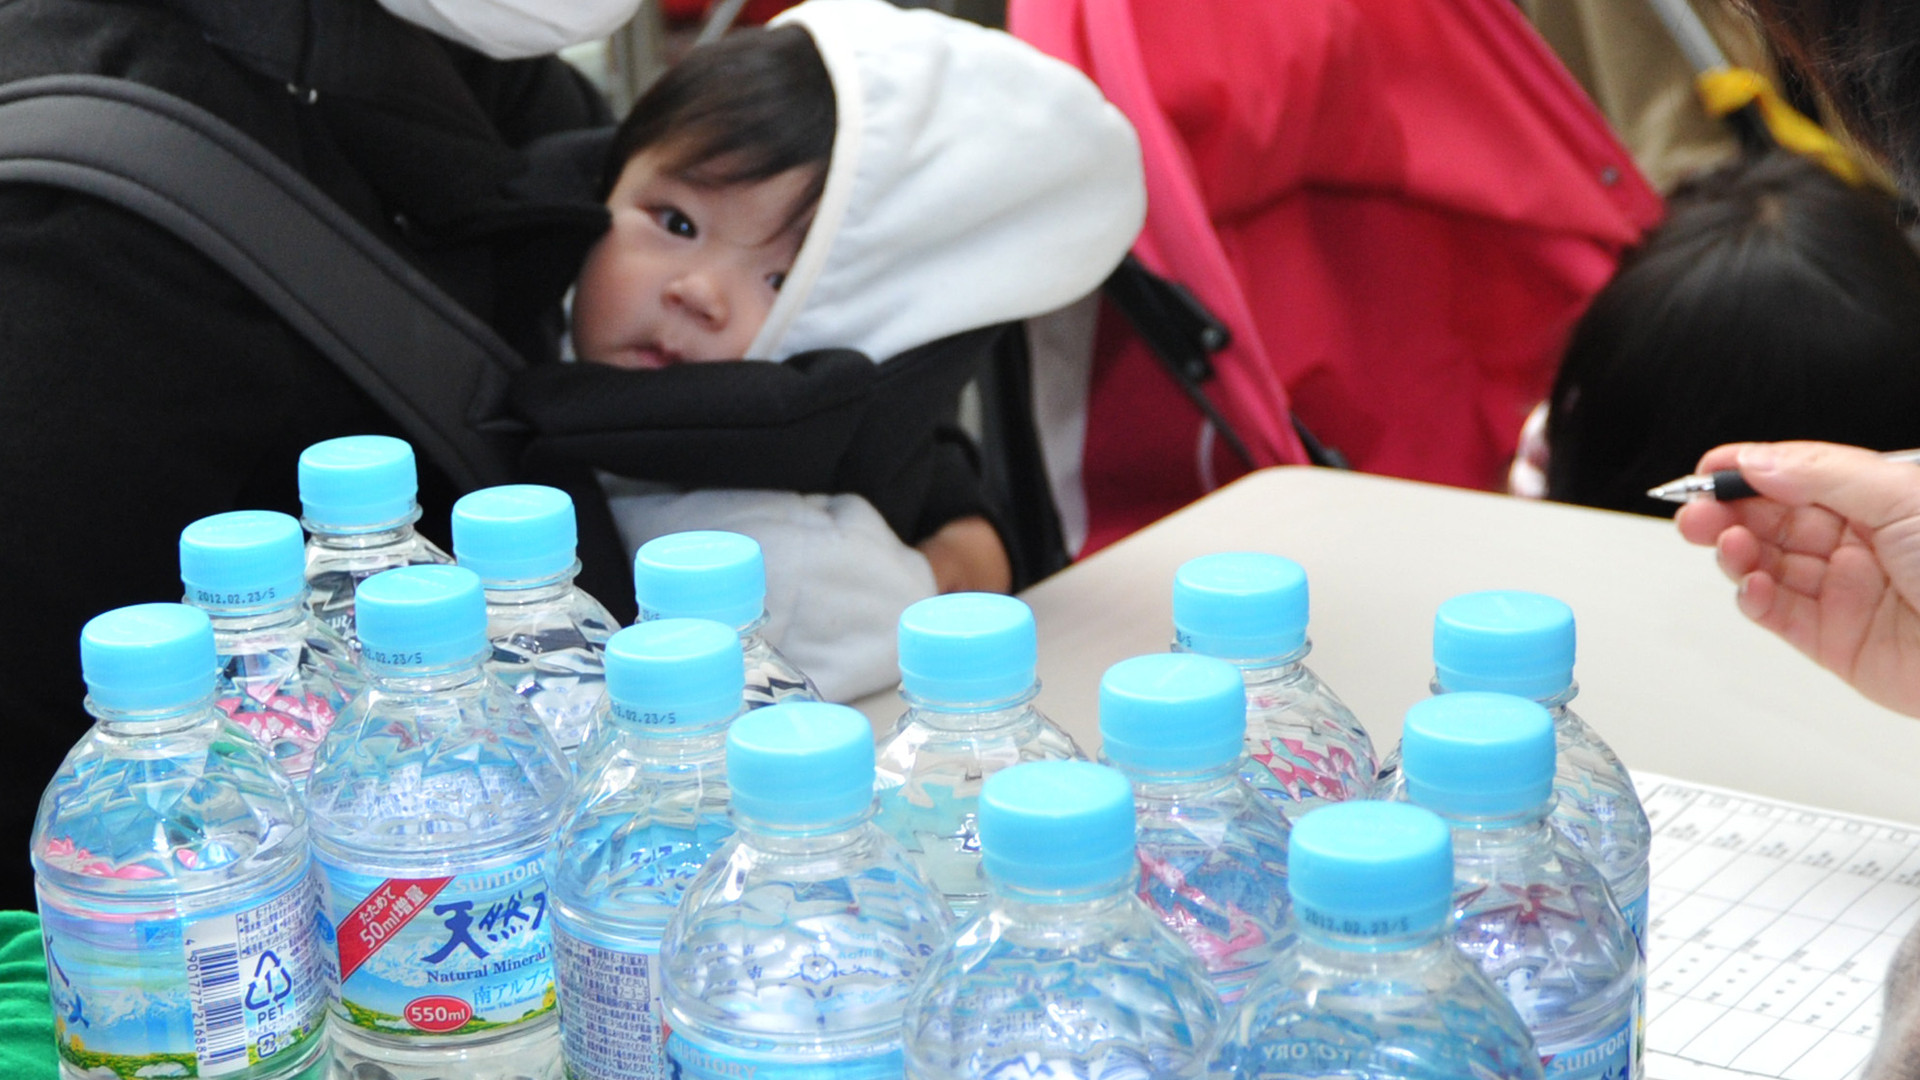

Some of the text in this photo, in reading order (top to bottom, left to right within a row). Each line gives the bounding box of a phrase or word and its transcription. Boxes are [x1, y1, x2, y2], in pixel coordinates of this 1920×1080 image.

[197, 587, 276, 605] 2012.02.23/5
[359, 886, 397, 926] たためて
[360, 883, 430, 949] 50ml増量
[1303, 907, 1410, 936] 2012.02.23/5
[427, 964, 489, 984] Natural
[492, 946, 547, 977] Mineral
[257, 1002, 286, 1025] PET
[411, 1005, 467, 1023] 550ml
